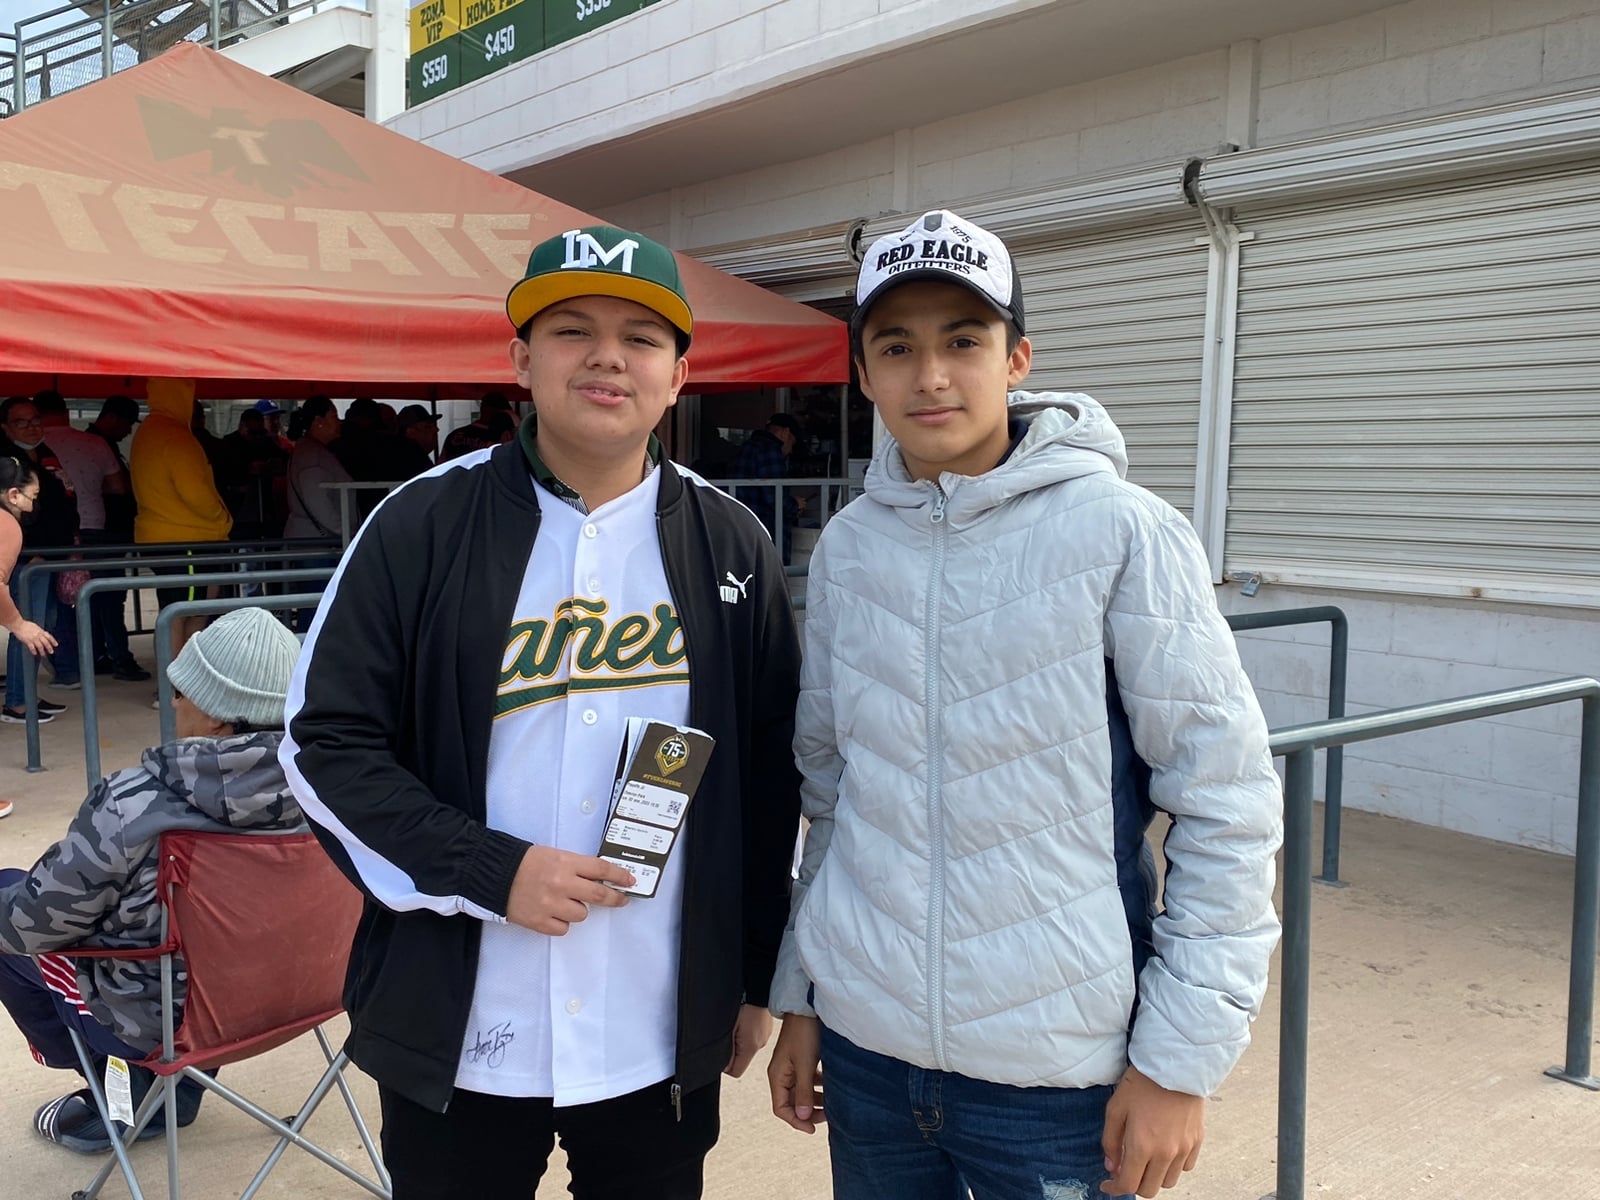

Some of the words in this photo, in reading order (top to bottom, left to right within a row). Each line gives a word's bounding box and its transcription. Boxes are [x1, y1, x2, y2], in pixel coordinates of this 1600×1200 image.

[466, 0, 496, 26] HOME
[427, 20, 443, 44] VIP
[485, 24, 515, 62] $450
[422, 54, 448, 88] $550
[0, 161, 531, 280] TECATE
[876, 243, 915, 271] RED
[920, 239, 988, 271] EAGLE
[889, 260, 971, 275] OUTFITTERS
[666, 741, 682, 758] 75
